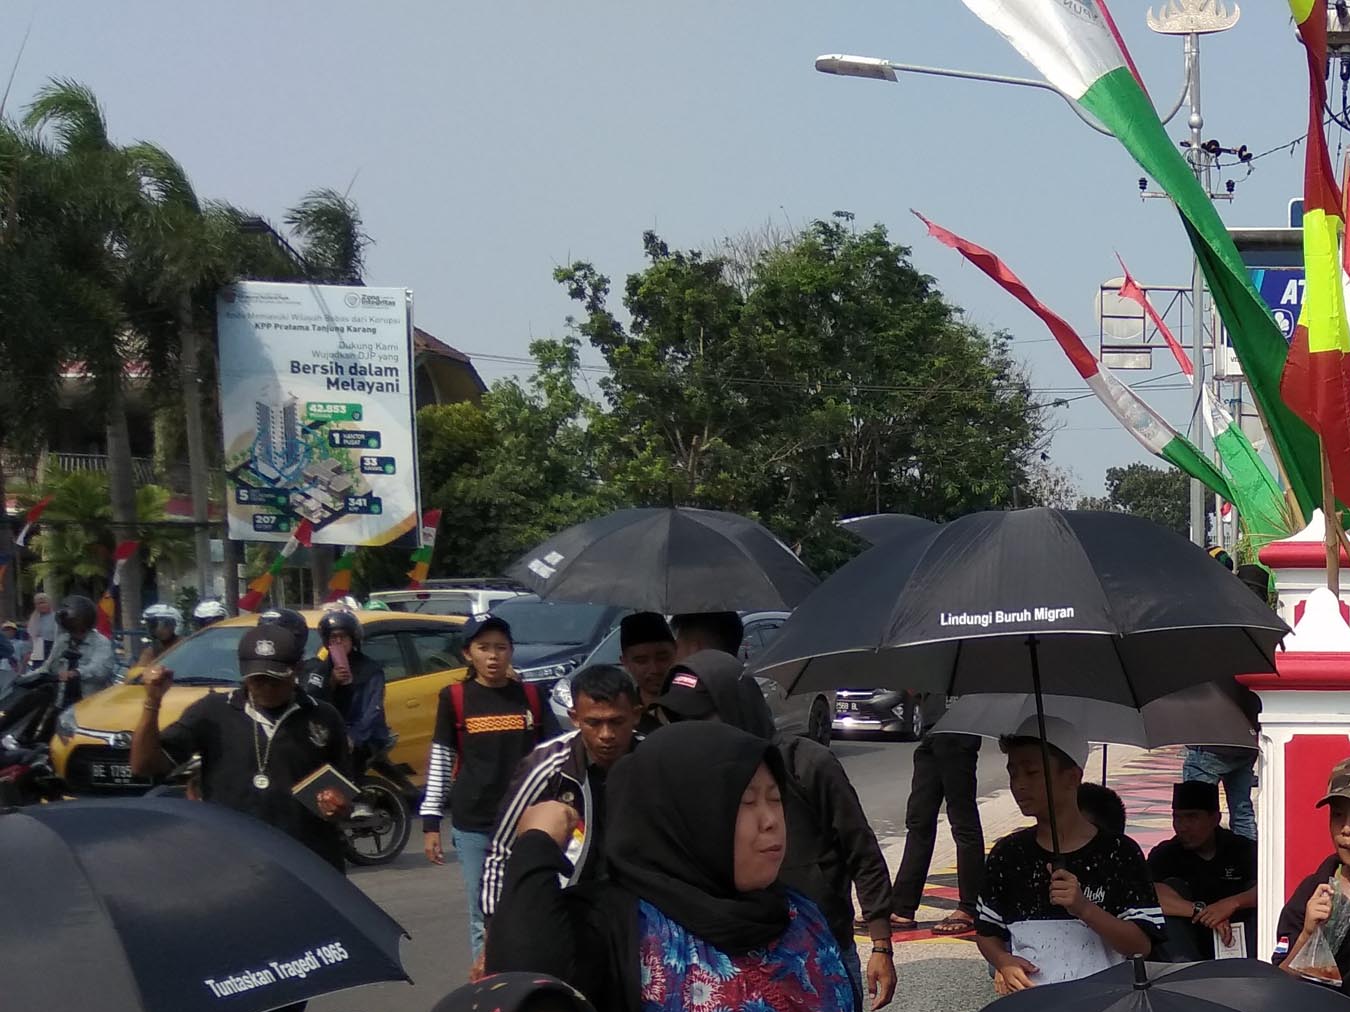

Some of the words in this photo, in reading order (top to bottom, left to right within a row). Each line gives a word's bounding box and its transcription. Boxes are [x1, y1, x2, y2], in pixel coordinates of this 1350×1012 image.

[255, 322, 272, 330] KPP
[274, 323, 310, 331] Pratama
[312, 324, 344, 334] Tanjung
[347, 325, 377, 335] Karang
[339, 341, 373, 351] Dukung
[375, 342, 399, 351] Kami
[358, 351, 376, 360] DJP
[378, 353, 399, 363] yang
[290, 360, 345, 376] Bersih
[348, 362, 399, 378] dalam
[326, 377, 400, 395] Melayani
[239, 489, 249, 501] 5
[255, 515, 277, 524] 207
[940, 612, 993, 627] Lindungi
[995, 609, 1032, 624] Buruh
[1034, 607, 1075, 622] Migran
[204, 970, 277, 998] Tuntaskan
[269, 950, 322, 979] Tragedi
[316, 941, 349, 965] 1965
